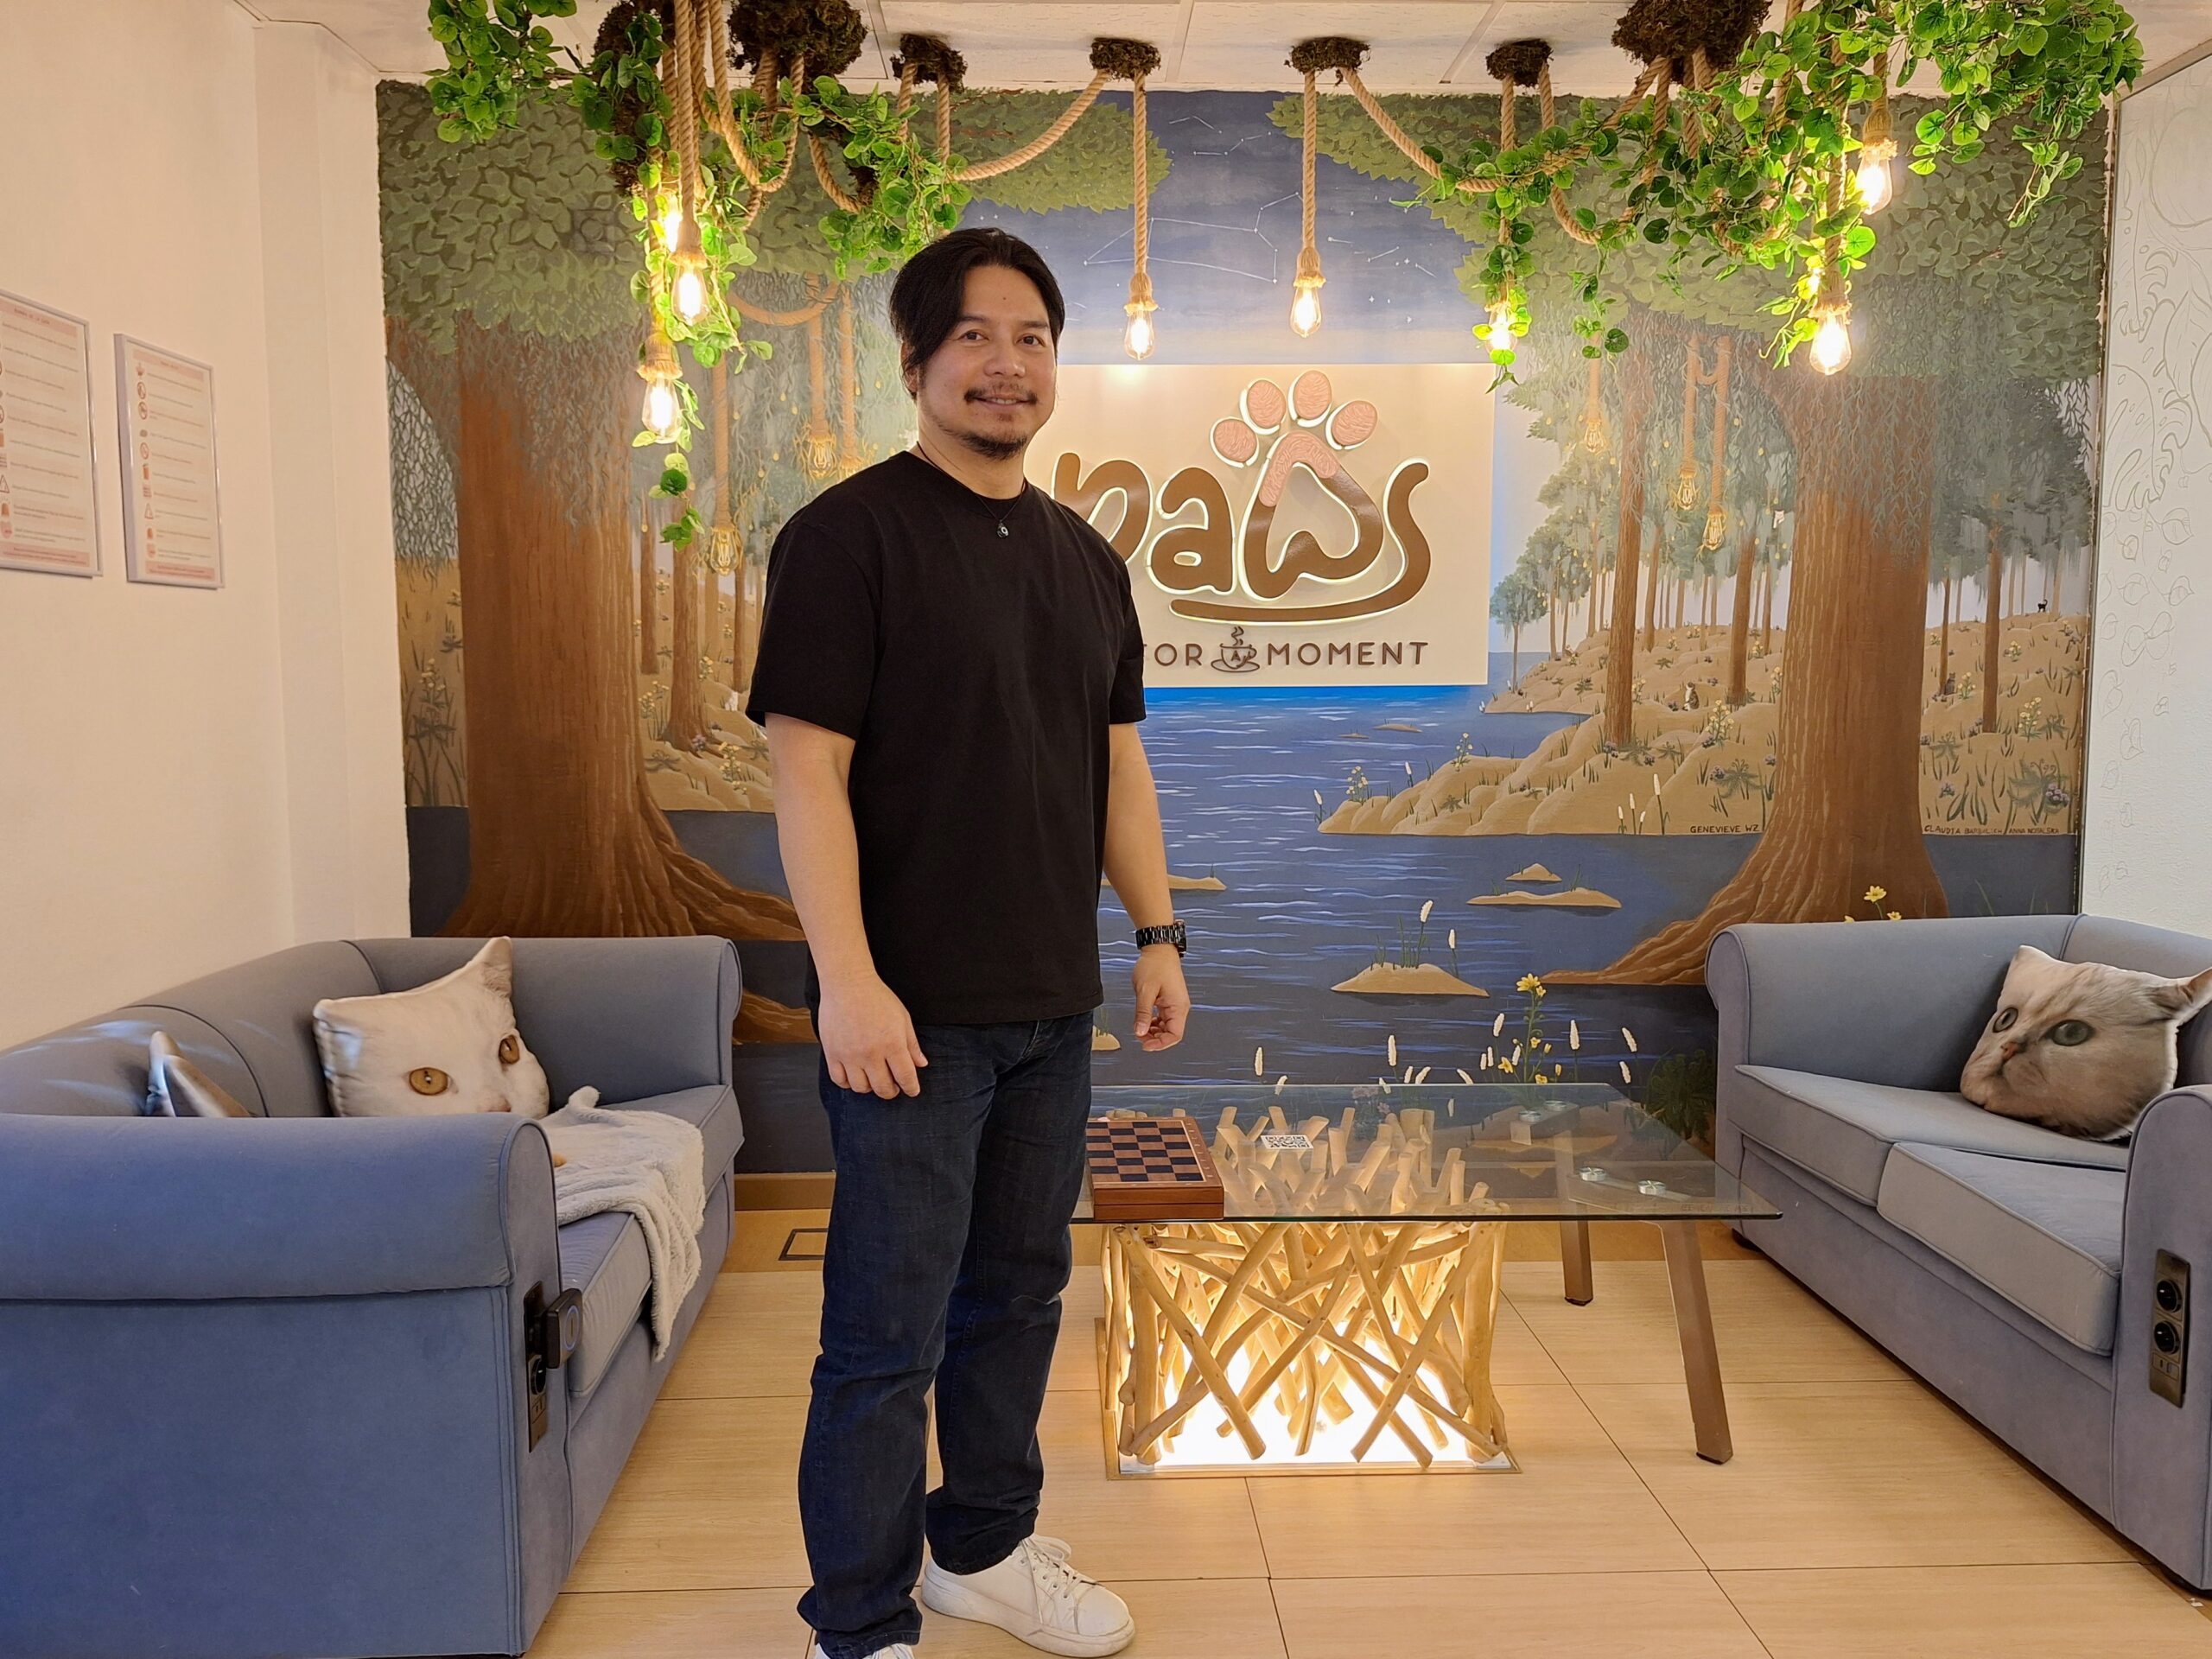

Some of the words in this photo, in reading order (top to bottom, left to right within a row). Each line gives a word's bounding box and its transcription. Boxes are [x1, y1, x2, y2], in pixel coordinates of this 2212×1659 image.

[1144, 643, 1203, 666] OR
[1268, 642, 1428, 665] MOMENT
[1923, 824, 1960, 835] CLAUDIA
